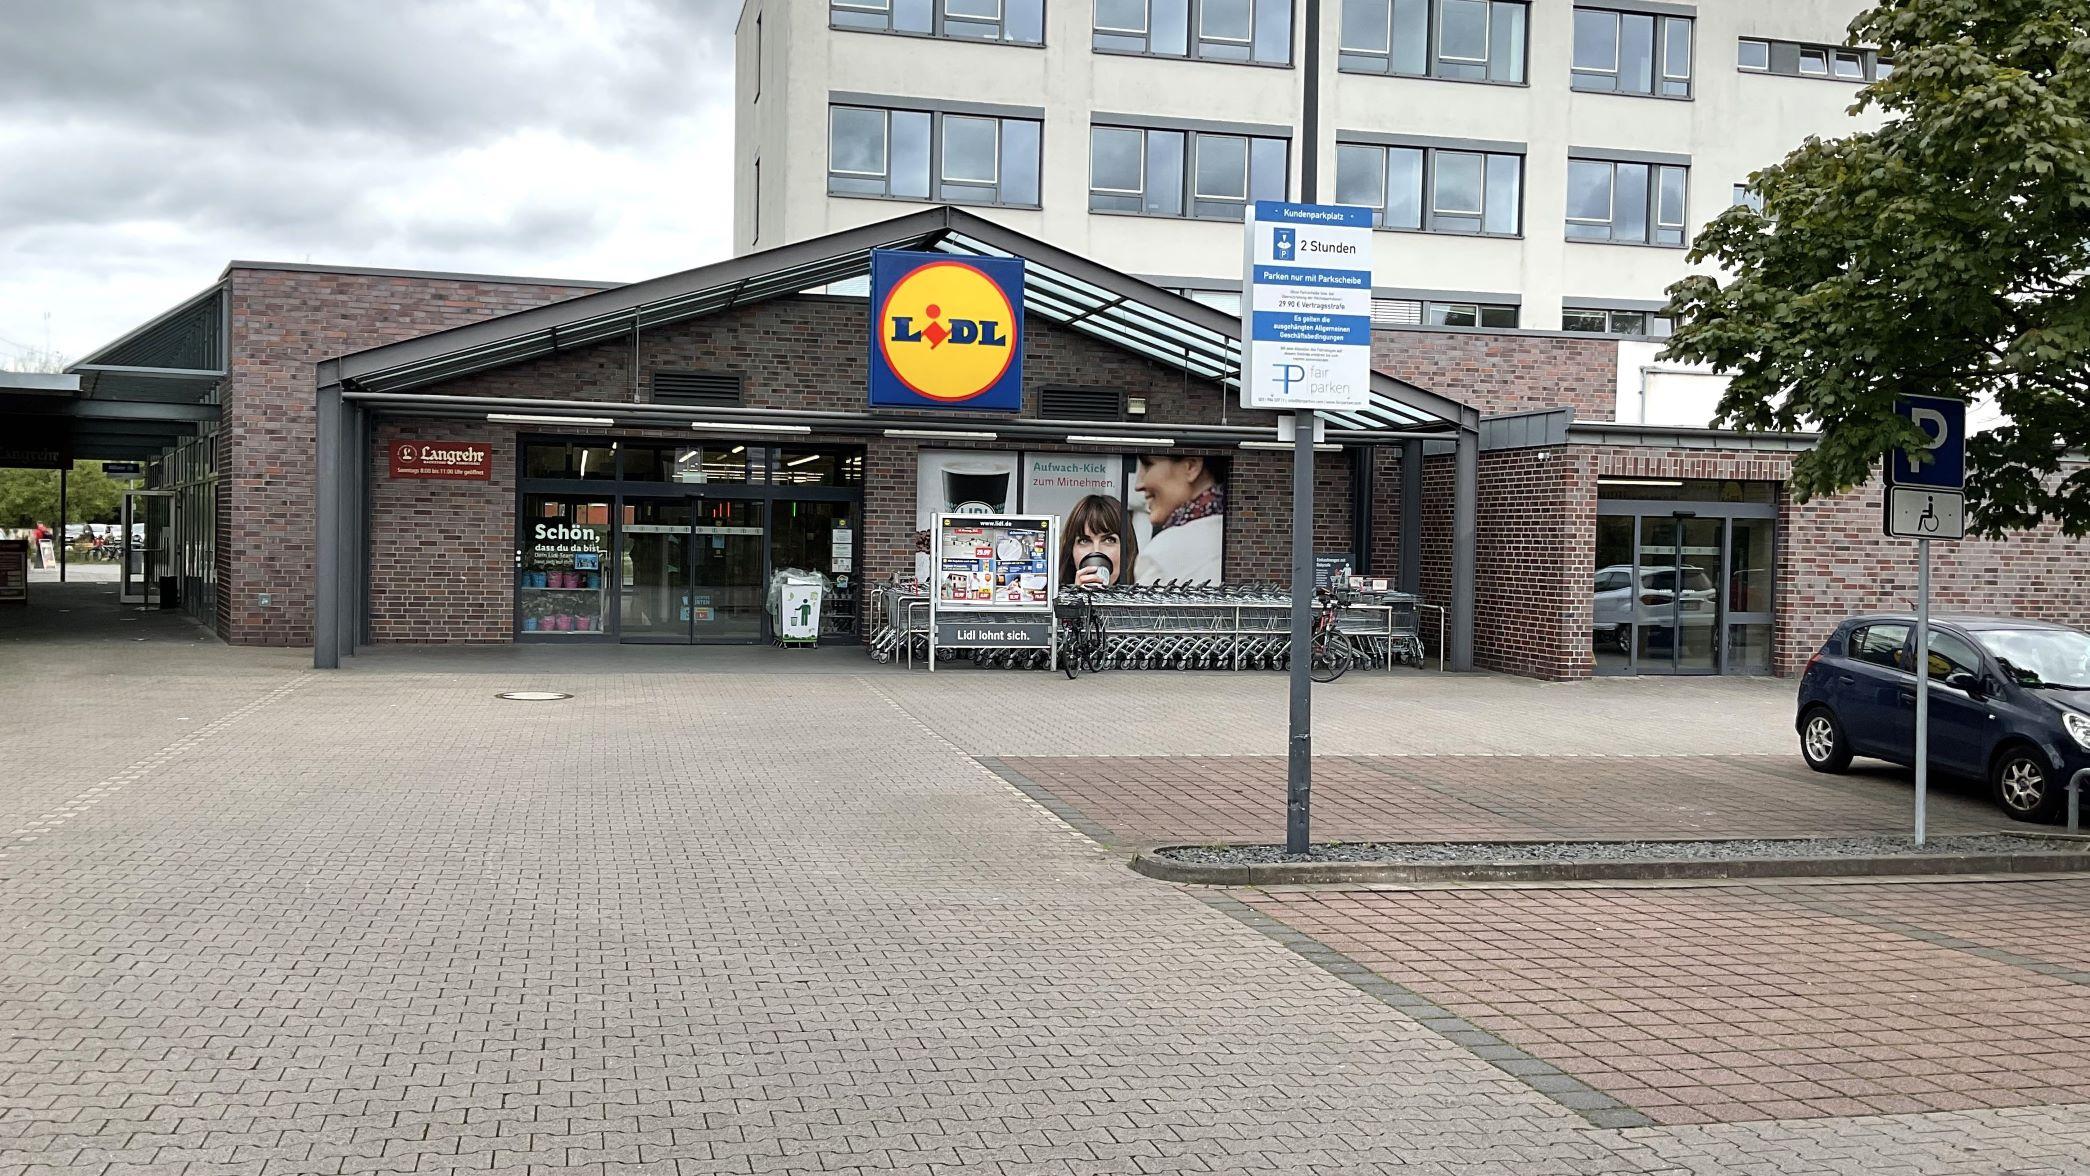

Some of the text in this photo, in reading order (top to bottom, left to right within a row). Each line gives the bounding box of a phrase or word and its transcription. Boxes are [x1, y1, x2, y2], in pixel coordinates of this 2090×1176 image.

[1283, 208, 1344, 221] Kundenparkplatz
[1300, 240, 1356, 254] 2 Stunden
[1263, 271, 1362, 285] Parken nur mit Parkscheibe
[1301, 301, 1346, 310] Vertragsstrafe
[1293, 314, 1301, 322] Es
[1302, 315, 1320, 324] gelten
[1273, 323, 1351, 333] ausgehängten Allgemeinen
[1279, 331, 1344, 342] Geschäftsbedingungen
[1310, 365, 1329, 379] fair
[1310, 381, 1350, 395] parken
[1911, 408, 1948, 473] P
[420, 446, 485, 465] Langrehr
[1033, 462, 1106, 474] Aufwach-Kick
[1033, 477, 1116, 488] zum Mitnehmen.
[535, 523, 600, 543] Schön,
[534, 543, 555, 552] dass
[556, 543, 569, 552] du
[570, 544, 582, 552] da
[957, 629, 1030, 641] Lidl lohnt sich.
